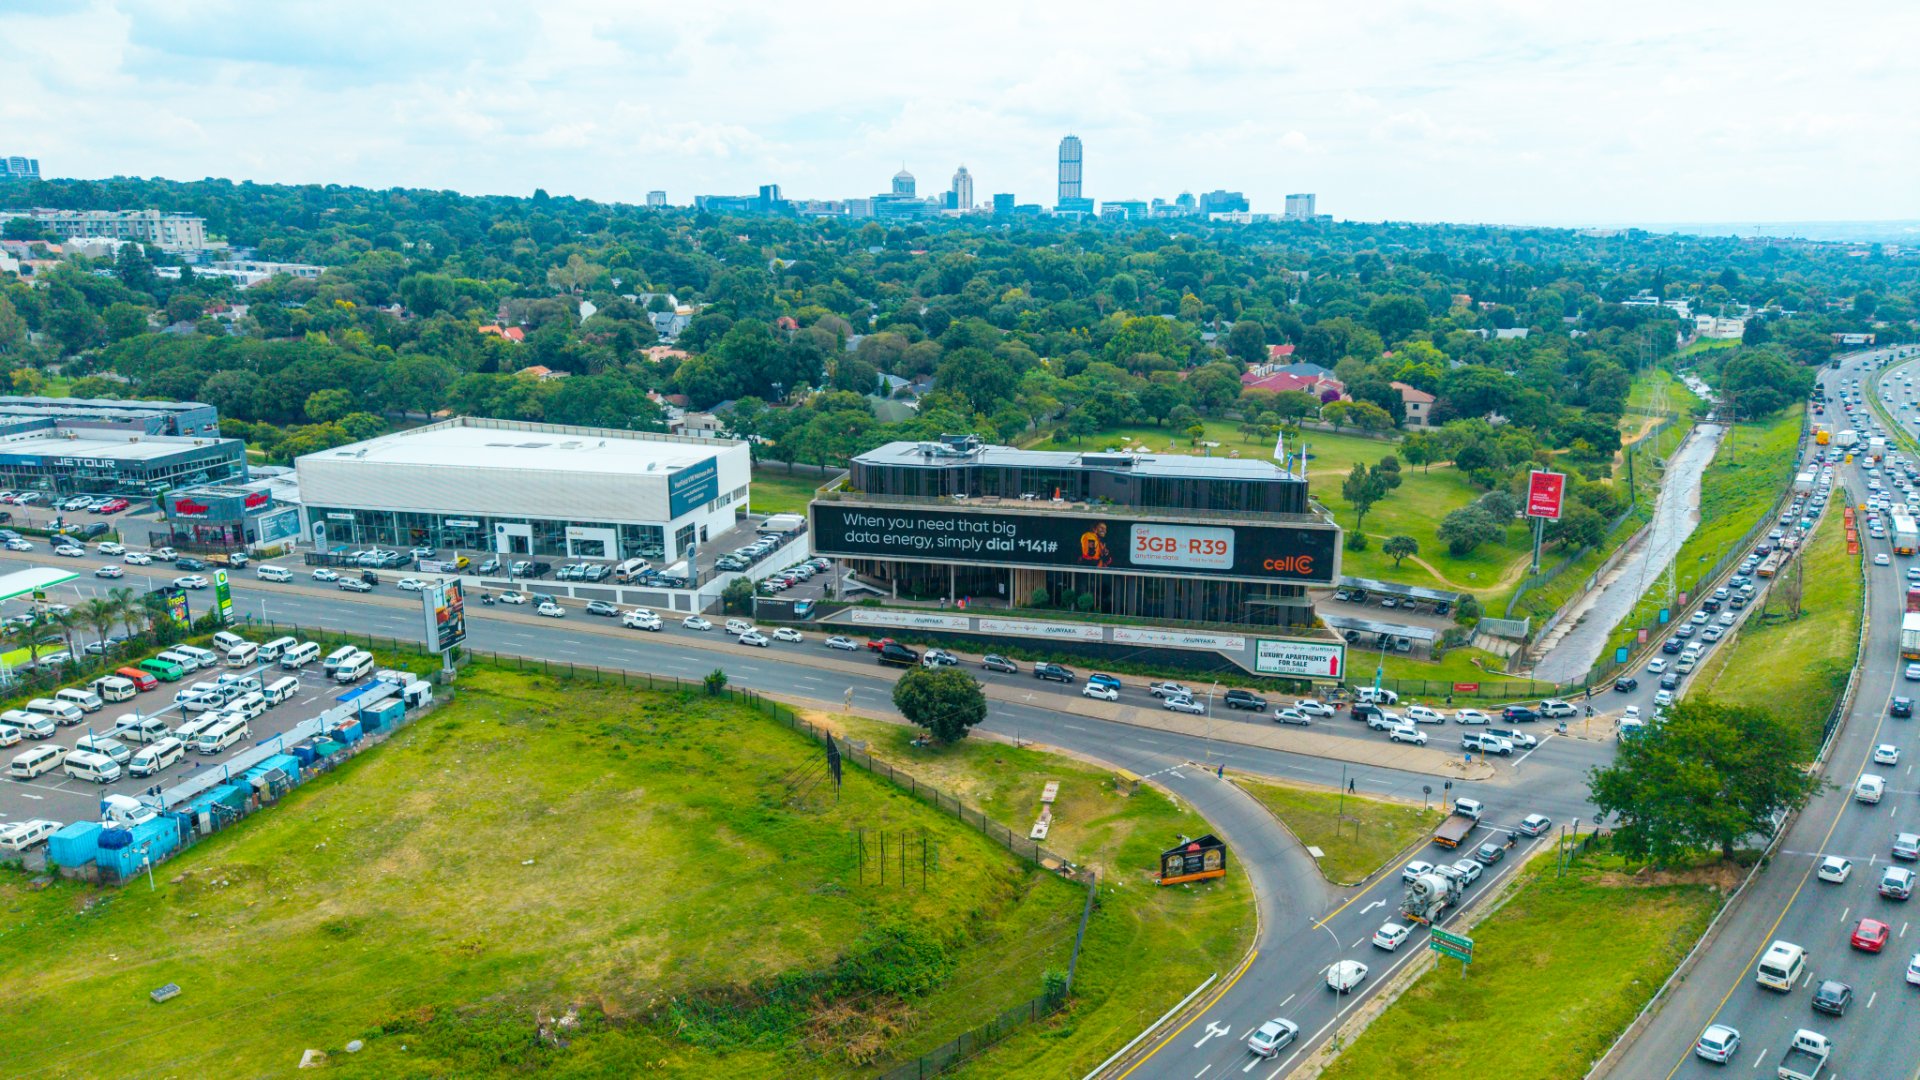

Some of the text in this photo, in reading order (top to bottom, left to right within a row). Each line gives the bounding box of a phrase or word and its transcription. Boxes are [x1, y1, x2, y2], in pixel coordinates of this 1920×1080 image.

[54, 457, 115, 469] JETOUR
[843, 513, 1016, 537] When you need that big
[1136, 528, 1150, 536] Get
[845, 530, 880, 544] data
[883, 533, 934, 549] energy,
[937, 535, 983, 552] simply
[986, 537, 1014, 551] dial
[1136, 536, 1177, 553] 3GB
[1189, 538, 1227, 555] R39
[167, 595, 185, 606] free
[914, 617, 944, 625] MUNYAKA
[1183, 636, 1216, 645] MUNYAKA
[1260, 651, 1327, 662] LUXURY APARTMENTS
